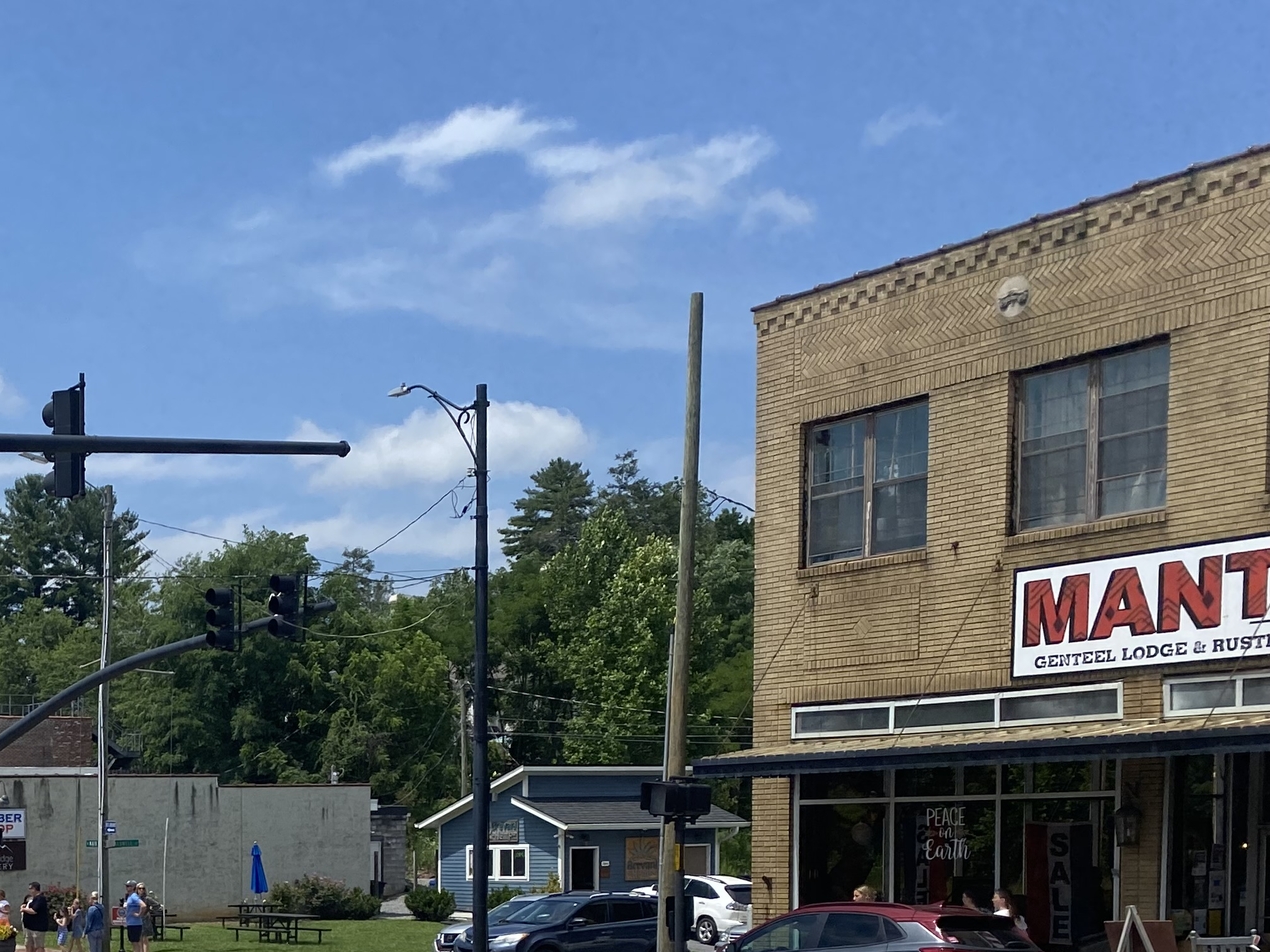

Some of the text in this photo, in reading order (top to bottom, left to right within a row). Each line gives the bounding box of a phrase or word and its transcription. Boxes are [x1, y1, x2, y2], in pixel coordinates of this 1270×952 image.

[1034, 649, 1117, 670] GENTEEL
[1122, 641, 1188, 662] LODGE
[1193, 640, 1206, 654] &
[926, 806, 966, 827] PEACE
[938, 827, 954, 839] on
[922, 838, 971, 860] Earth
[1050, 832, 1071, 939] SALE
